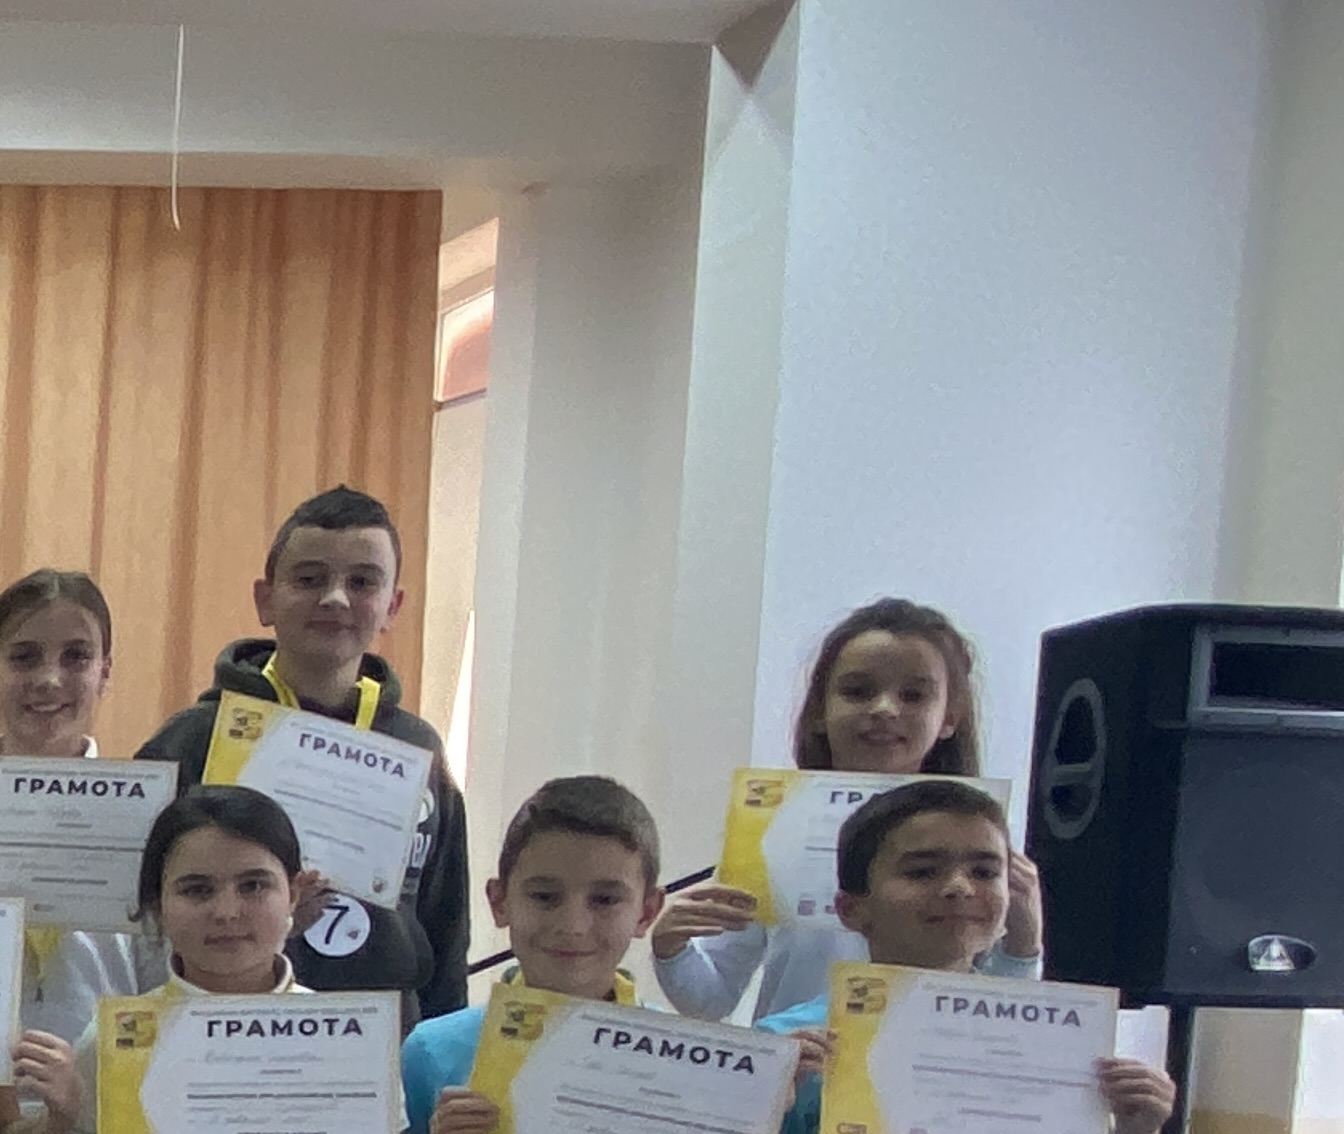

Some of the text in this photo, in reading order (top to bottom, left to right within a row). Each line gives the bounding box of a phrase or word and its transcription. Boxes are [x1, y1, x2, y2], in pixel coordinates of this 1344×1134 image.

[299, 733, 406, 778] ГРАМОТА
[14, 778, 146, 798] ГРАМОТА
[324, 905, 350, 945] 7
[207, 1018, 363, 1038] ГРАМОТА
[935, 996, 1081, 1027] ГРАМОТА
[593, 1027, 755, 1074] ГРАМОТА
